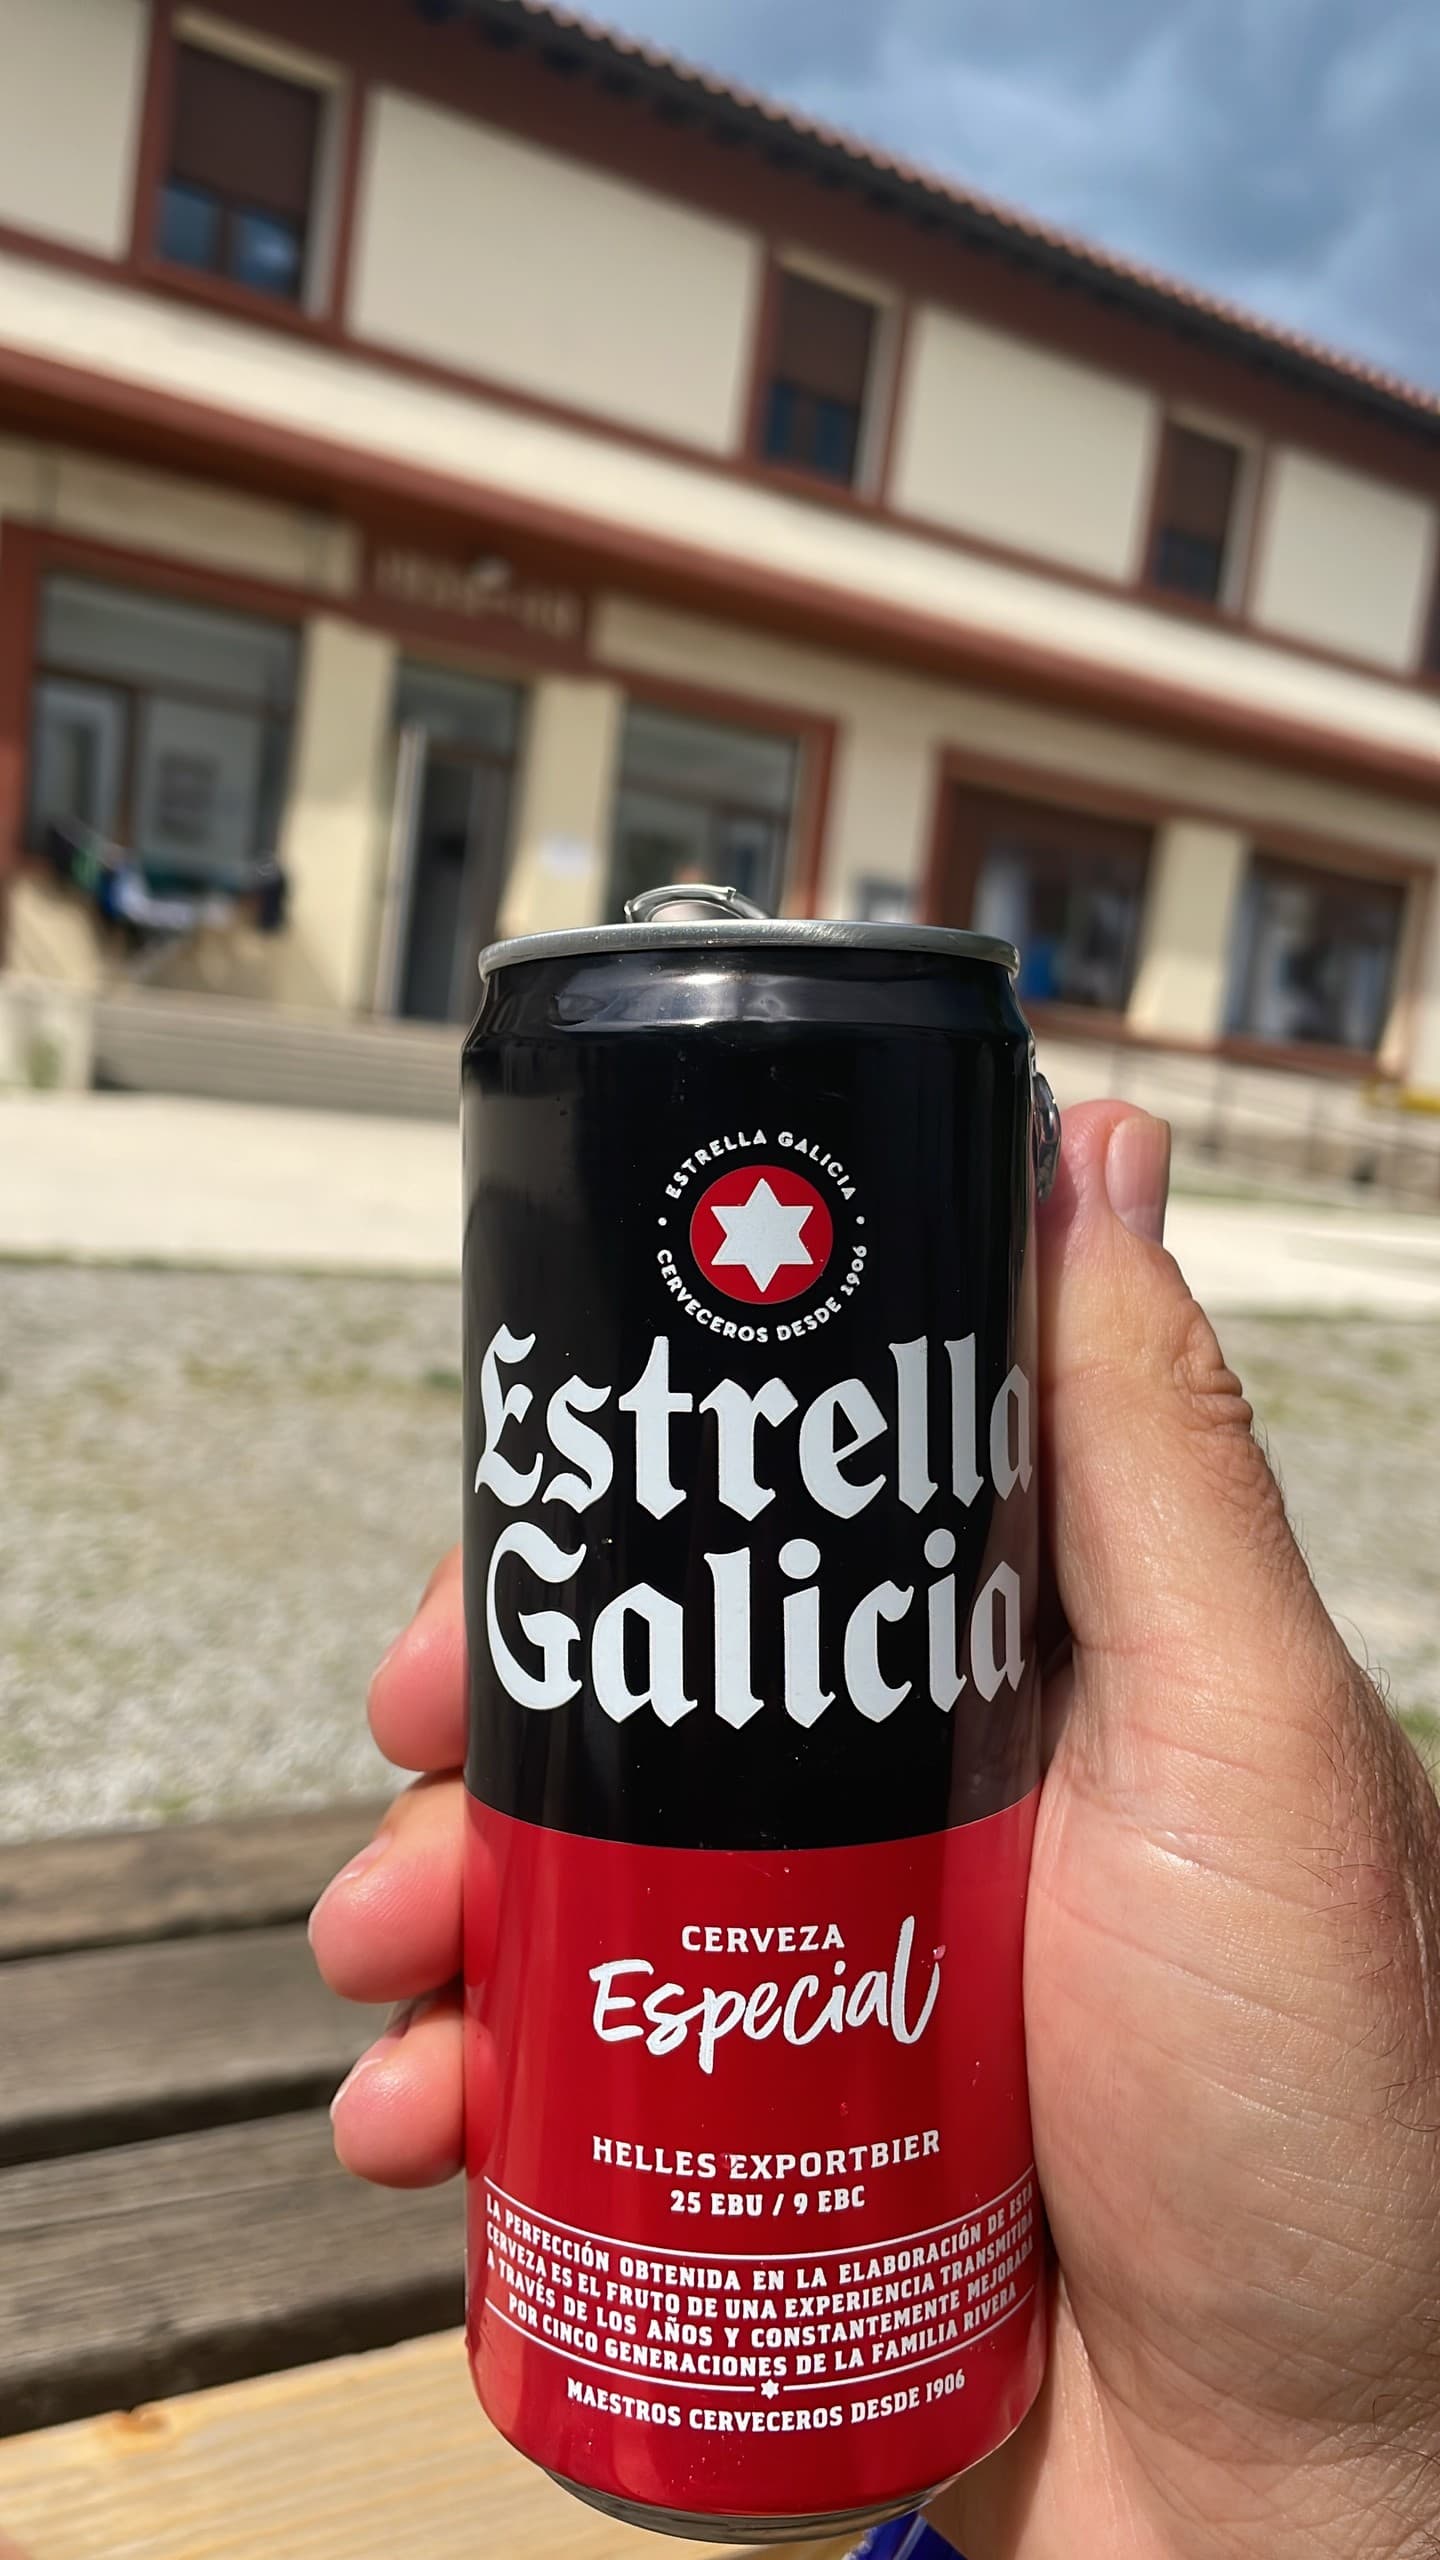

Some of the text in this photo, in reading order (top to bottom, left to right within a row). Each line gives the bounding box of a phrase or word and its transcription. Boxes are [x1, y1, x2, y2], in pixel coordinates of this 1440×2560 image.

[665, 1129, 856, 1200] ESTRELLA GALICIA
[657, 1245, 867, 1342] CERVECEROS DESDE 1906
[474, 1324, 1033, 1521] Estrella
[486, 1521, 1025, 1729] Galicia
[681, 1924, 845, 1953] CERVEZA
[588, 1915, 940, 2074] Especial
[593, 2129, 941, 2180] HELLES EXPORTBIER
[670, 2185, 865, 2216] 25 EBU / 9 EBC
[486, 2193, 501, 2221] LA
[505, 2208, 609, 2271] PERFECCIÓN
[620, 2257, 741, 2290] OBTENIDA
[753, 2270, 784, 2290] EN
[797, 2267, 827, 2289] LA
[839, 2223, 981, 2284] ELABORACIÓN
[988, 2208, 1005, 2236] DE
[487, 2221, 547, 2278] CERVEZA
[551, 2262, 573, 2288] ES
[578, 2272, 601, 2297] EL
[606, 2281, 680, 2314] FRUTO
[688, 2296, 717, 2318] DE
[725, 2299, 777, 2320] UNA
[785, 2272, 935, 2318] EXPERIENCIA
[487, 2248, 495, 2270] A
[499, 2257, 555, 2309] TRAVÉS
[563, 2295, 587, 2321] DE
[596, 2307, 637, 2335] LOS
[647, 2313, 712, 2346] AÑOS
[724, 2327, 739, 2348] Y
[751, 2290, 960, 2348] CONSTANTEMENTE
[508, 2282, 1016, 2377] POR CINCO GENERACIONES DE LA FAMILIA RIVERA
[567, 2368, 965, 2432] MAESTROS CERVECEROS DESDE 1906
